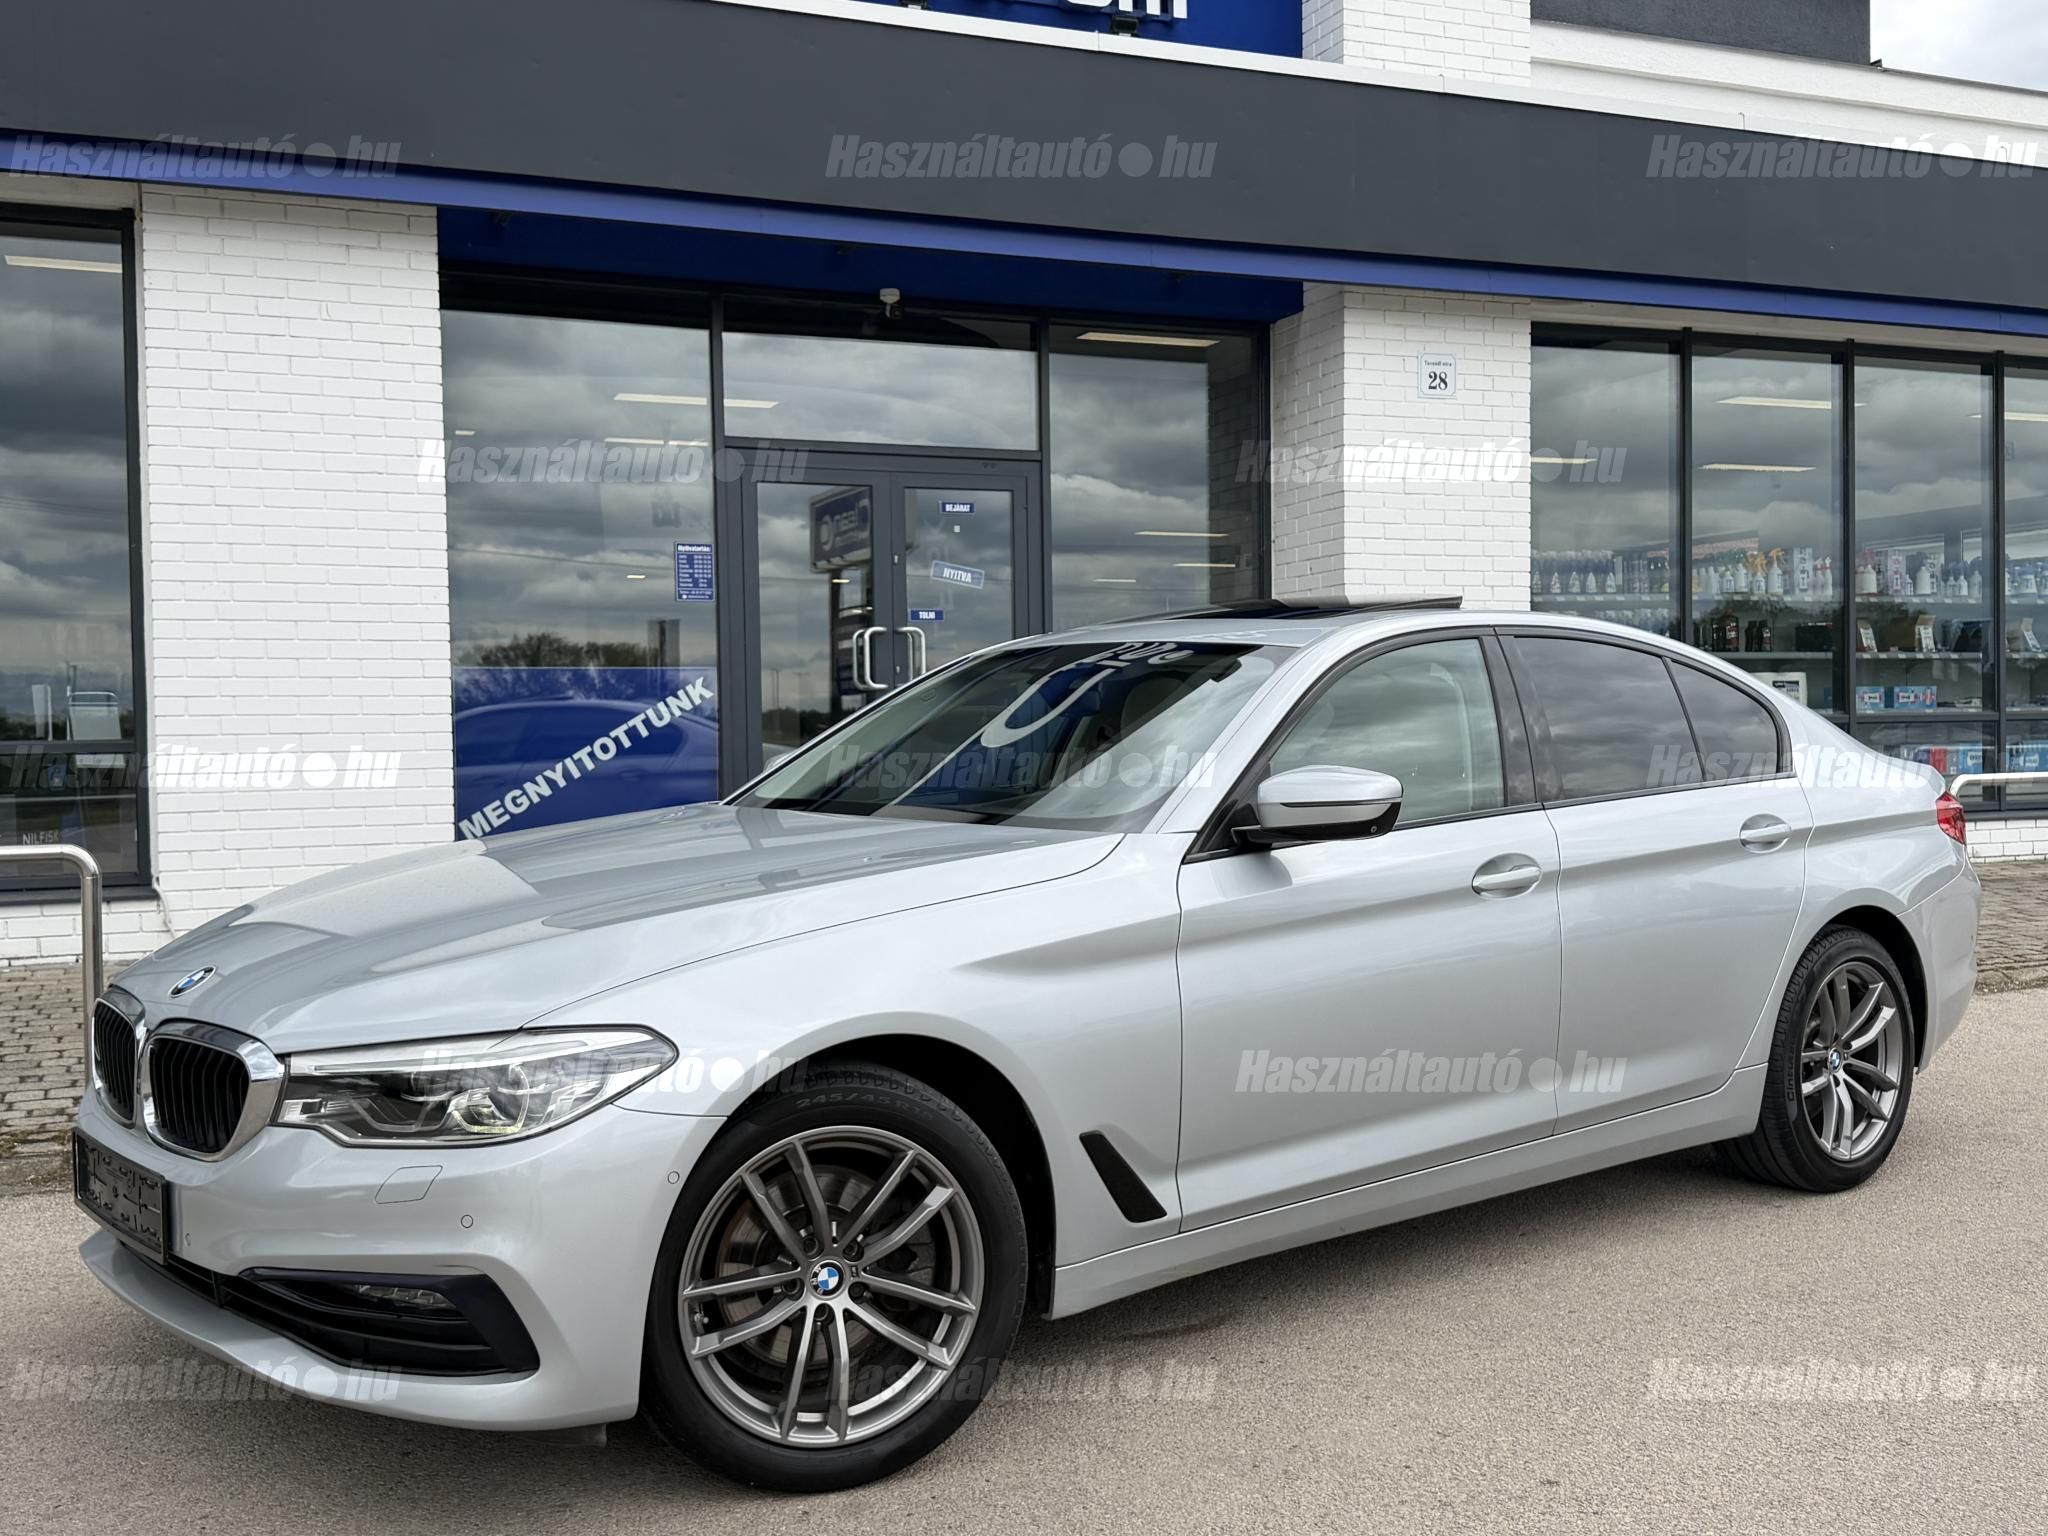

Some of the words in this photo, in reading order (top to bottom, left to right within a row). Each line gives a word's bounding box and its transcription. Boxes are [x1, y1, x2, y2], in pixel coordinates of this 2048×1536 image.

[1428, 370, 1448, 391] 28
[943, 567, 972, 583] NYITVA
[459, 676, 714, 840] MEGNYITOTTUNK
[22, 830, 59, 846] NILFISK
